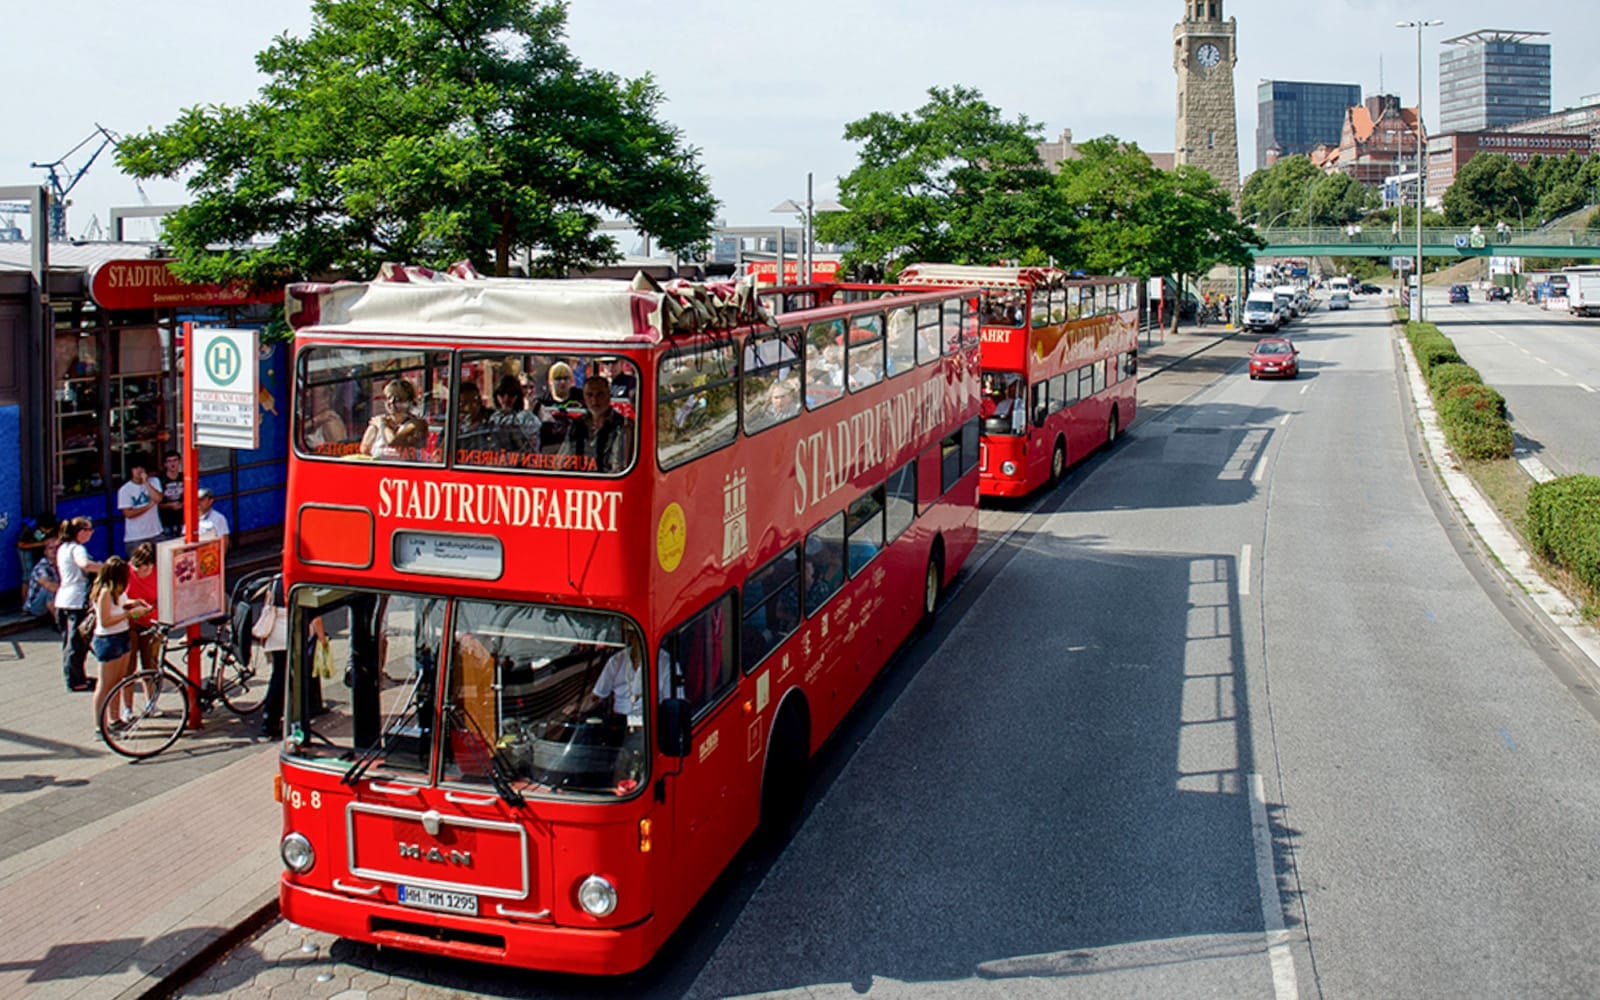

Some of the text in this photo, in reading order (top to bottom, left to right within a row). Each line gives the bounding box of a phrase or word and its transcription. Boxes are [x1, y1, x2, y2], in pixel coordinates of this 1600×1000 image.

[108, 265, 184, 288] STADTRU
[214, 347, 231, 375] H
[794, 374, 945, 517] STADTRUNDFAHRT
[378, 477, 623, 533] STADTRUNDFAHRT
[310, 790, 322, 809] 8
[428, 891, 445, 906] MM
[447, 894, 476, 910] 1295
